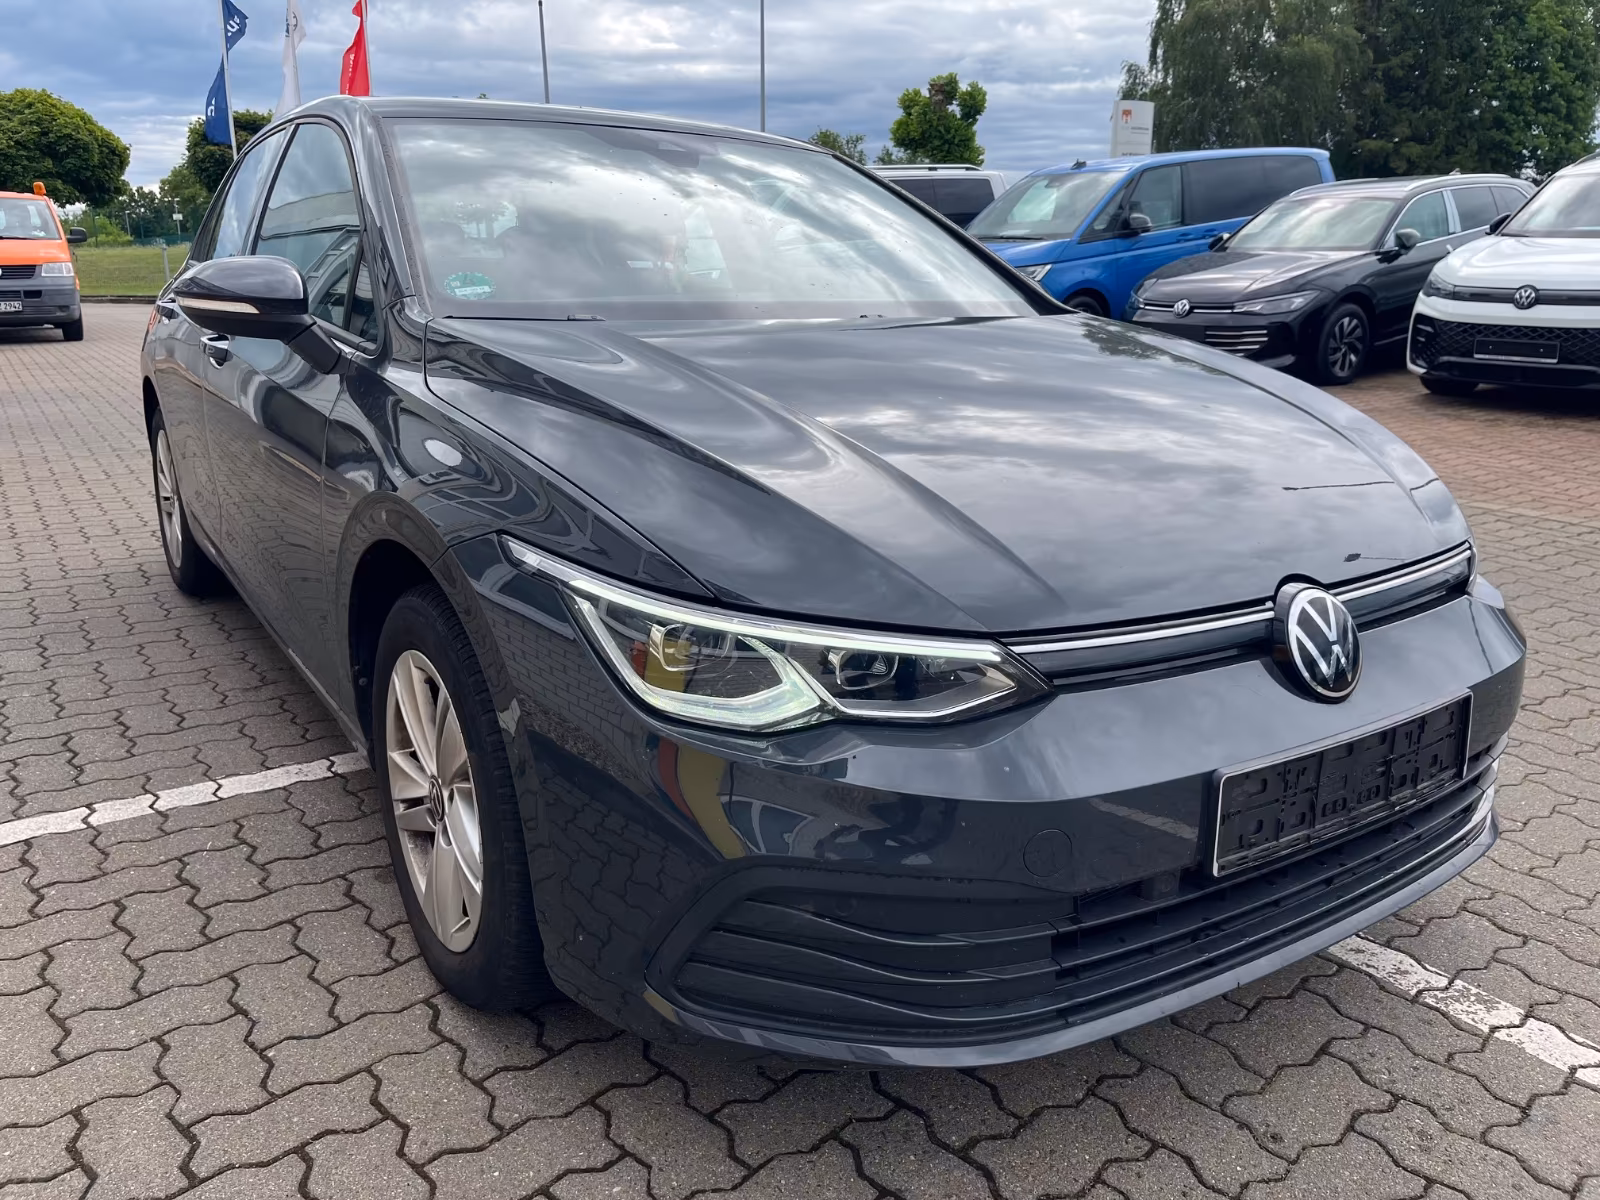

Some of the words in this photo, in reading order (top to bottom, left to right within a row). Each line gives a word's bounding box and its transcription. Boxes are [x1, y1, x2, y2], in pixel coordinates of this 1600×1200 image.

[3, 302, 21, 310] 2942
[1515, 287, 1536, 308] VW
[1174, 300, 1190, 318] VW
[1289, 589, 1358, 692] VW
